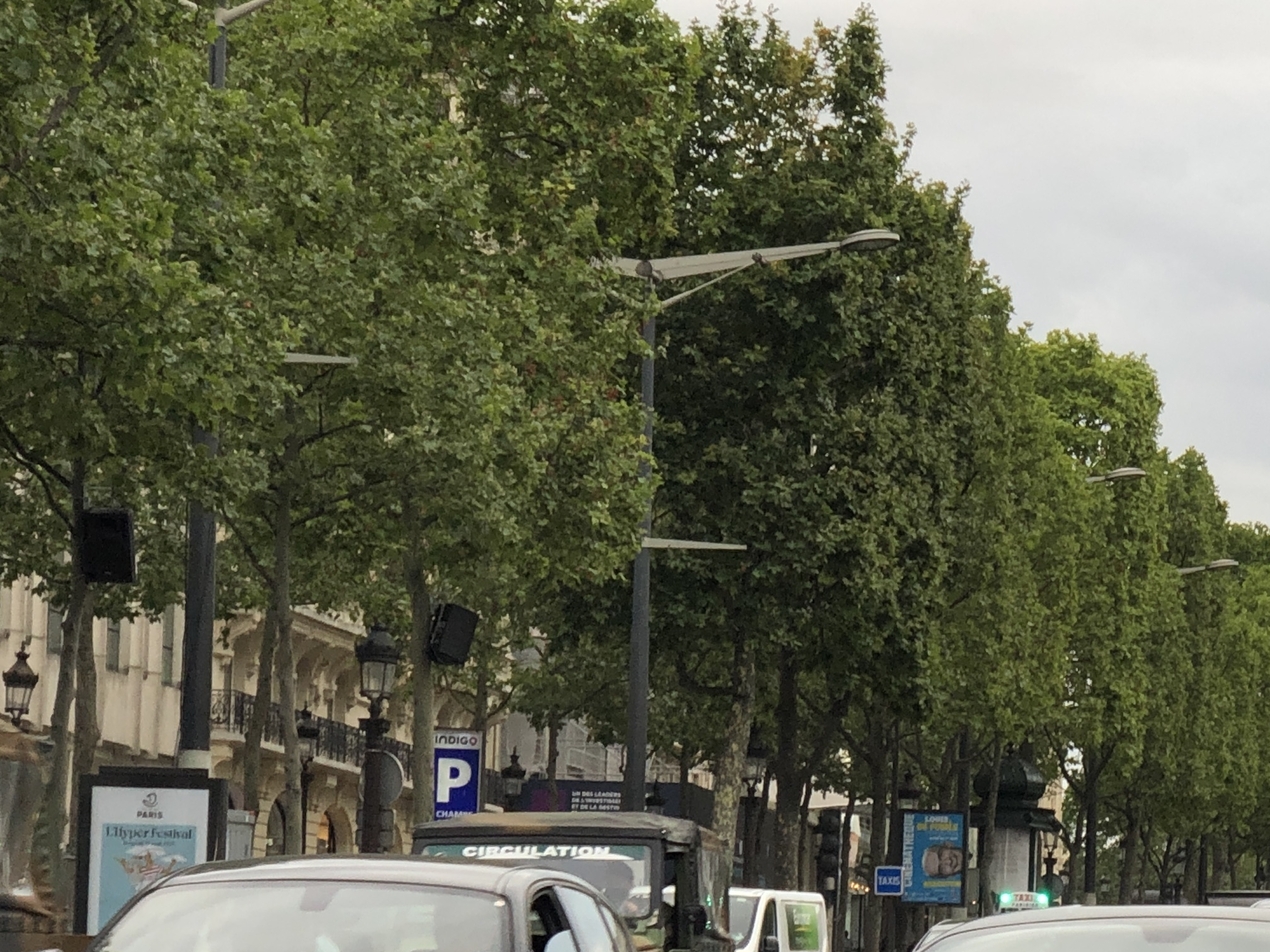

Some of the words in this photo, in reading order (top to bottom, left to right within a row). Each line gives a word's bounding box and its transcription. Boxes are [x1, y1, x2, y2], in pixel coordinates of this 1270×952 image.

[436, 757, 472, 803] P
[137, 811, 163, 819] PARIS
[462, 846, 611, 857] CIRCULATION
[878, 875, 900, 886] TAXIS
[1013, 893, 1034, 901] TAXI
